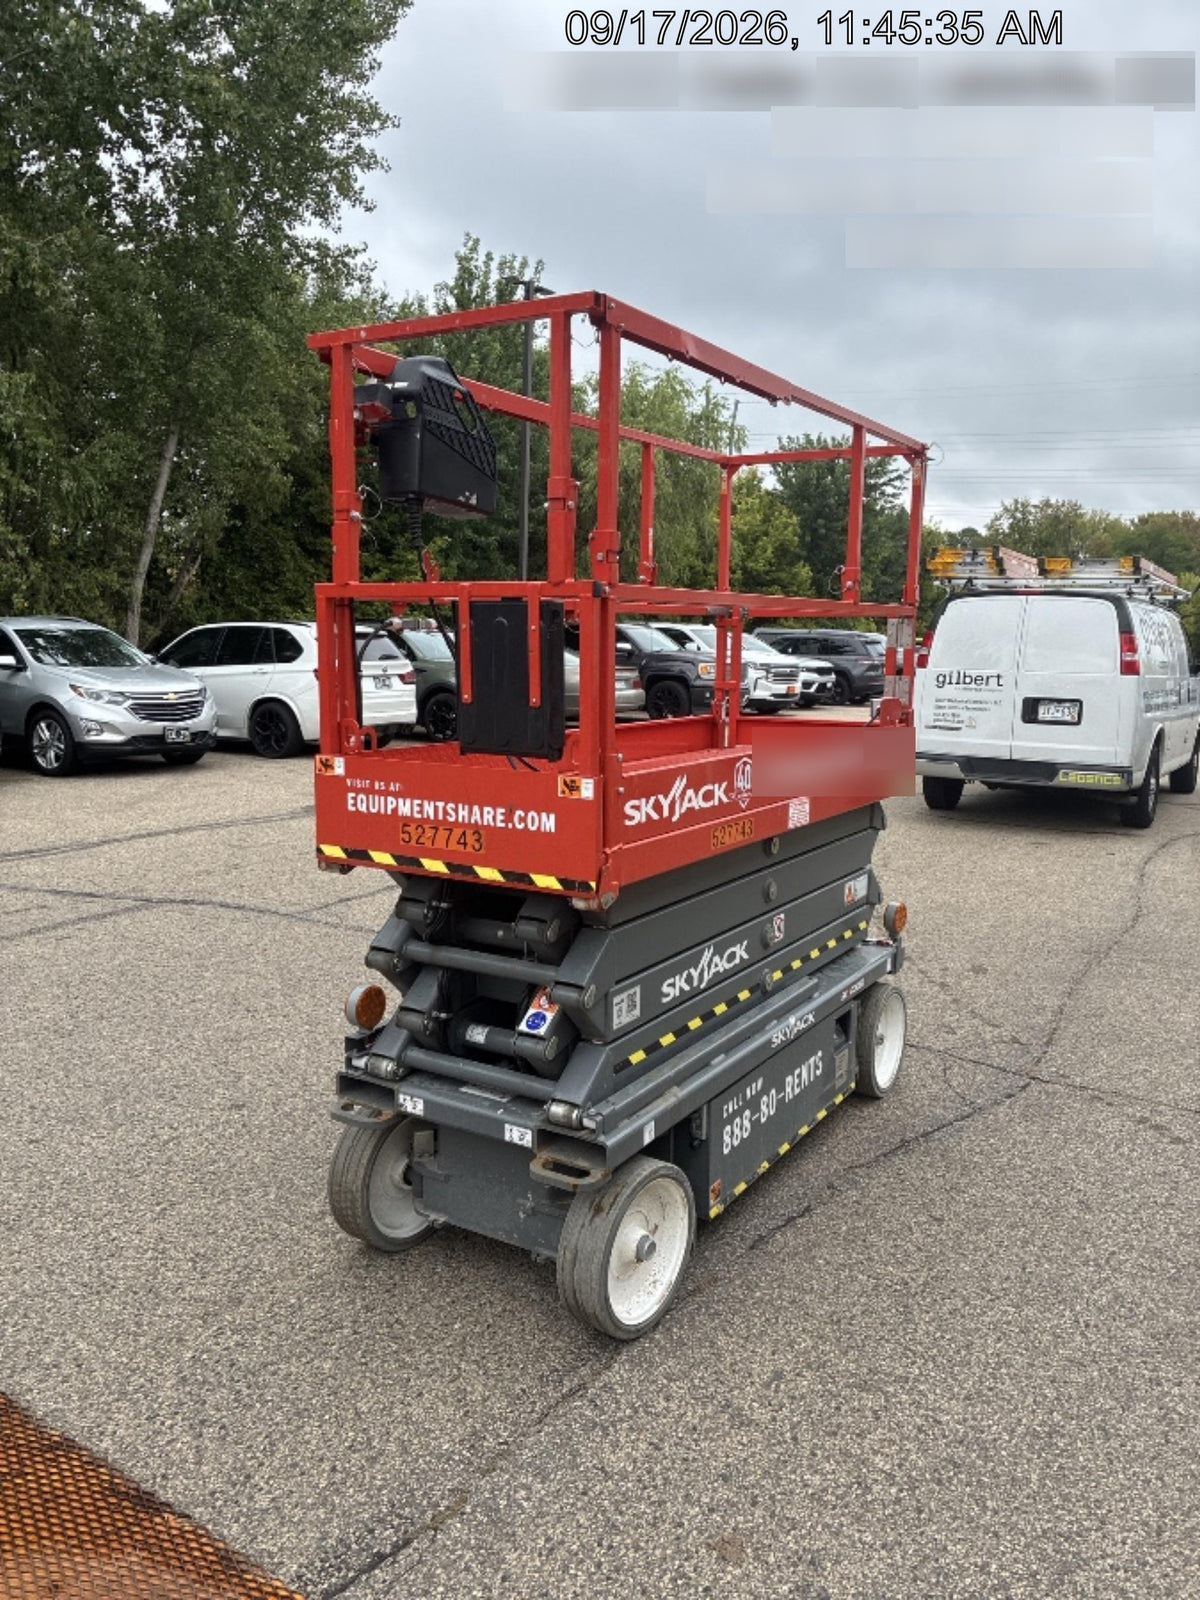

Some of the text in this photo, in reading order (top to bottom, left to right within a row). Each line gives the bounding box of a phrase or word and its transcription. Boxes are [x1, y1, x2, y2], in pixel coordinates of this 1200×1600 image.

[935, 671, 1003, 688] gilbert
[346, 778, 370, 789] VISIT
[623, 774, 729, 826] SKYJACK
[347, 792, 556, 833] EQUIPMENTSHARE.COM
[400, 823, 484, 852] 527743
[712, 818, 753, 848] 527743
[660, 940, 750, 1004] SKYJACK
[770, 1010, 816, 1048] SKYJACK
[723, 1050, 823, 1155] 888-80-RENTS
[723, 1093, 743, 1119] CALL
